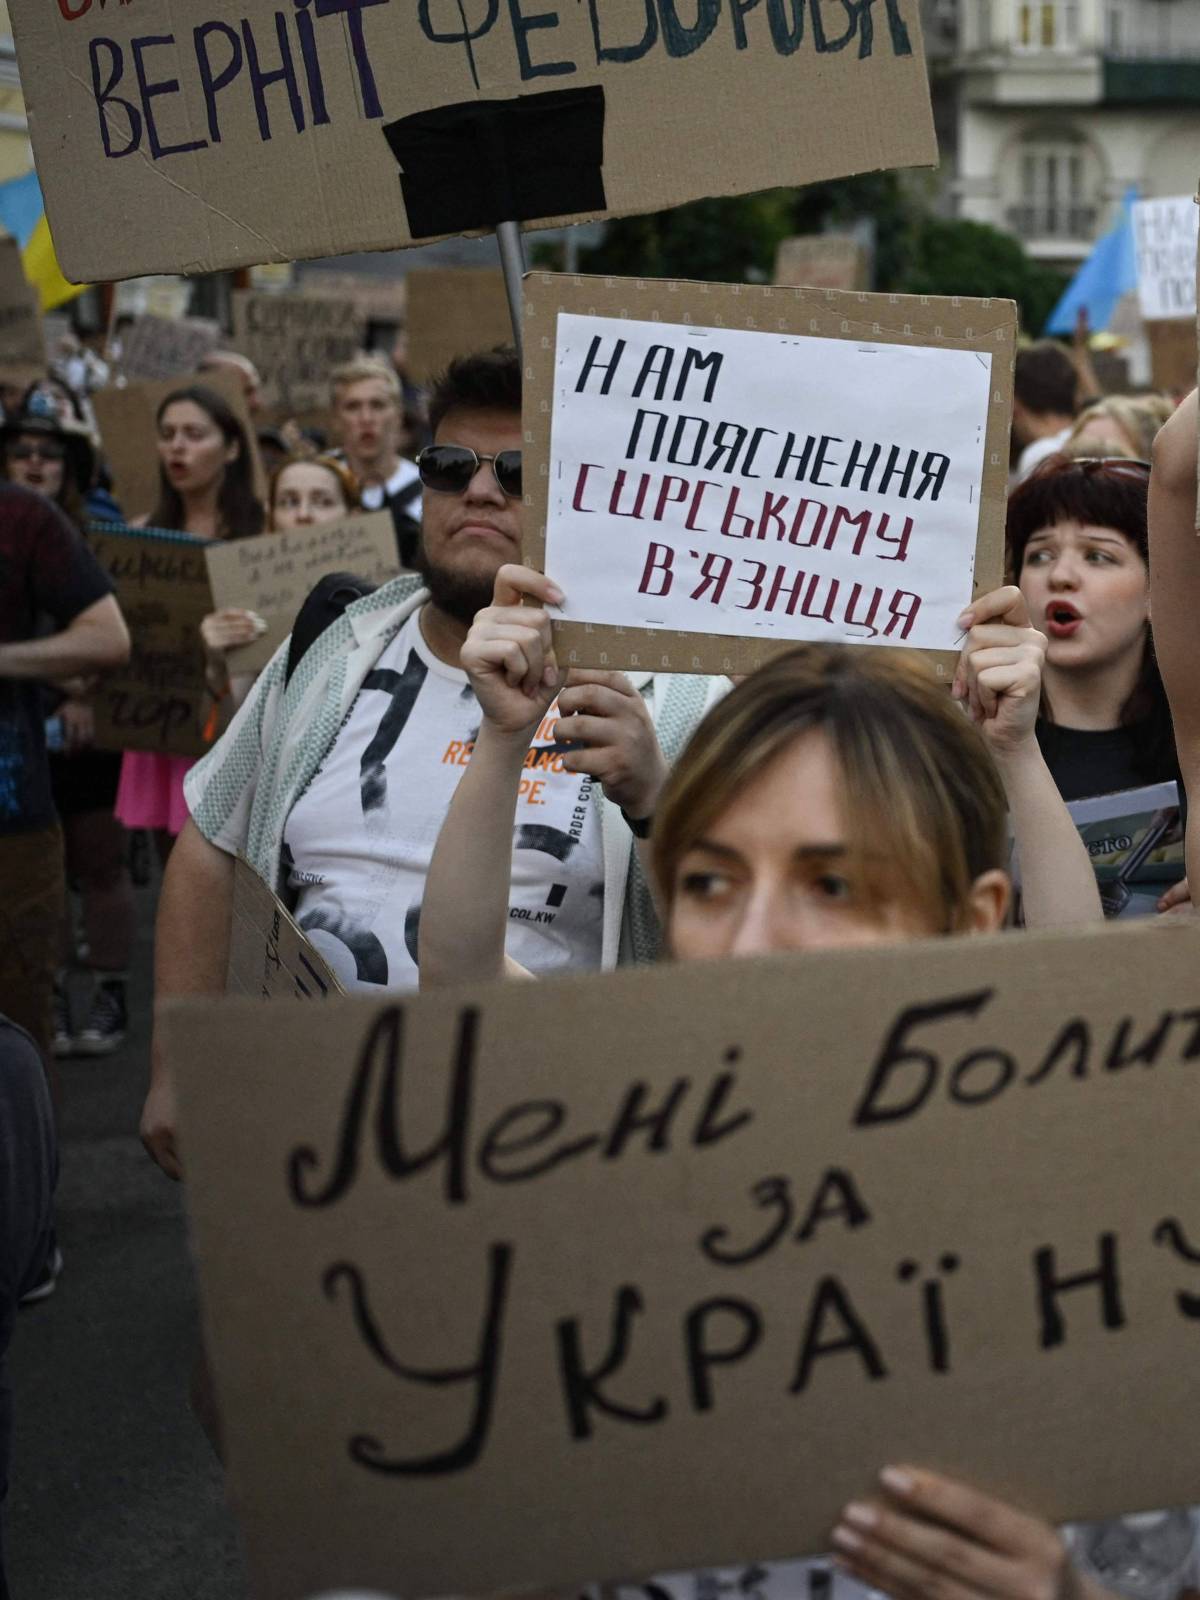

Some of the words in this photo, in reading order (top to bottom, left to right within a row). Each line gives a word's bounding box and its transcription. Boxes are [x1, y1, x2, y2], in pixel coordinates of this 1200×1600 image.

[574, 335, 724, 403] НАМ
[625, 408, 951, 502] ПОЯСНЕННЯ
[572, 462, 914, 562] СИРСЬКОМУ
[288, 1001, 753, 1209] Мені
